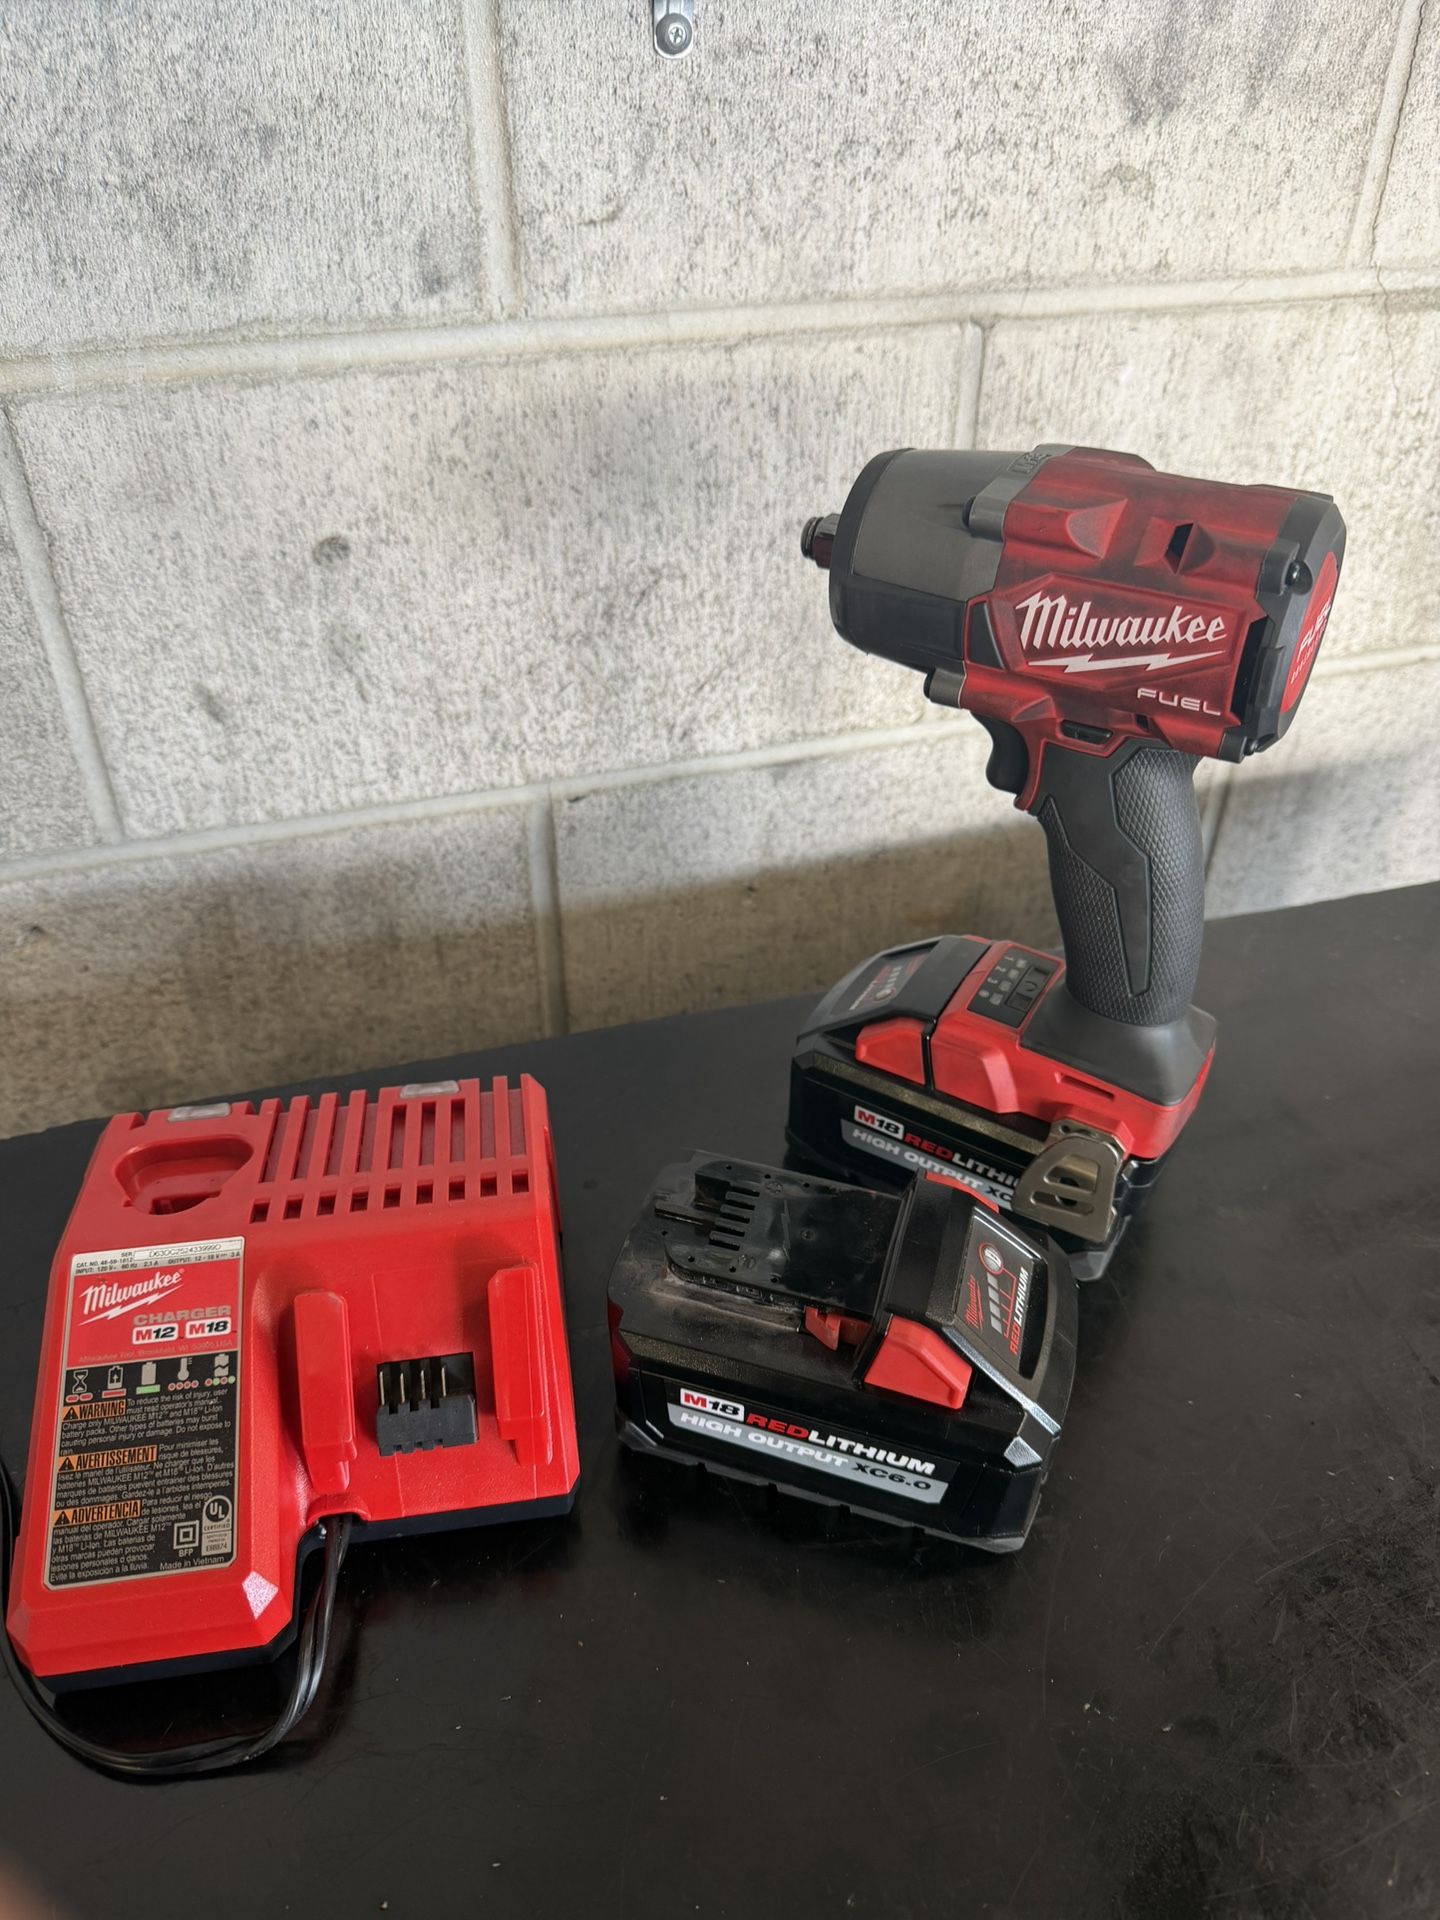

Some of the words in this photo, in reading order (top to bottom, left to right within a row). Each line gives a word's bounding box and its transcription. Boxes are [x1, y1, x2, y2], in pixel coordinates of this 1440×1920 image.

[1015, 590, 1227, 650] Milwaukee
[1136, 686, 1221, 716] FUEL
[855, 1108, 901, 1135] M18
[903, 1132, 1018, 1186] REDLITHI
[852, 1127, 900, 1157] HIGH
[903, 1150, 984, 1191] OUTPUT
[79, 1271, 183, 1315] Milwaukee
[132, 1305, 231, 1326] CHARGER
[1009, 1266, 1029, 1356] REDLITHIUM
[135, 1325, 176, 1341] M12
[188, 1319, 229, 1335] M18
[126, 1398, 135, 1406] To
[136, 1395, 159, 1405] reduce
[160, 1394, 171, 1402] the
[171, 1392, 184, 1401] risk
[184, 1391, 192, 1399] of
[212, 1388, 228, 1396] user
[126, 1406, 143, 1414] must
[143, 1404, 159, 1412] read
[159, 1400, 193, 1411] operator's
[78, 1399, 124, 1419] WARNING
[61, 1429, 84, 1440] battery
[108, 1423, 128, 1433] Other
[128, 1422, 146, 1432] types
[147, 1419, 155, 1428] of
[156, 1416, 184, 1427] batteries
[185, 1416, 200, 1427] may
[200, 1413, 218, 1422] burst
[62, 1420, 87, 1432] Charge
[87, 1418, 102, 1429] only
[103, 1412, 146, 1426] MILWAUKEE
[168, 1409, 182, 1417] and
[60, 1438, 86, 1449] causing
[87, 1434, 117, 1446] personal
[117, 1431, 136, 1442] injury
[175, 1424, 186, 1433] Do
[186, 1423, 198, 1432] not
[198, 1421, 223, 1431] expose
[224, 1419, 231, 1427] to
[158, 1442, 174, 1451] Pour
[175, 1439, 207, 1450] minimiser
[208, 1437, 219, 1445] les
[683, 1392, 742, 1418] M18
[745, 1411, 937, 1476] REDLITHIUM
[75, 1445, 155, 1469] AVERTISSEMENT
[157, 1451, 178, 1462] risque
[179, 1449, 189, 1458] de
[679, 1411, 742, 1439] HIGH
[747, 1430, 850, 1469] OUTPUT
[852, 1461, 933, 1491] XC6.0
[104, 1466, 114, 1475] de
[152, 1461, 164, 1469] Ne
[164, 1457, 190, 1469] charger
[190, 1456, 204, 1466] que
[205, 1453, 215, 1462] les
[56, 1488, 87, 1500] marques
[87, 1486, 97, 1495] de
[98, 1482, 127, 1494] batteries
[186, 1473, 200, 1482] des
[200, 1468, 233, 1480] blessures
[87, 1472, 132, 1486] MILWAUKEE
[55, 1500, 65, 1508] ou
[65, 1497, 79, 1506] des
[141, 1497, 158, 1506] Para
[158, 1494, 182, 1504] reducir
[183, 1492, 190, 1501] el
[141, 1507, 150, 1515] de
[182, 1501, 193, 1510] lea
[194, 1500, 201, 1508] el
[70, 1500, 139, 1524] ADVERTENCIA
[208, 1500, 226, 1520] UL
[53, 1525, 79, 1536] manual
[79, 1523, 91, 1532] del
[125, 1515, 150, 1527] Cargar
[151, 1511, 186, 1523] solamente
[92, 1531, 102, 1540] de
[103, 1524, 149, 1539] MILWAUKEE
[145, 1533, 156, 1542] de
[50, 1554, 68, 1564] otras
[69, 1551, 96, 1561] marcas
[96, 1547, 123, 1559] pueden
[159, 1559, 182, 1571] Made
[183, 1558, 191, 1567] in
[192, 1553, 224, 1566] Vietnam
[178, 1547, 193, 1557] BFP
[49, 1562, 79, 1573] lesiones
[79, 1556, 118, 1570] personales
